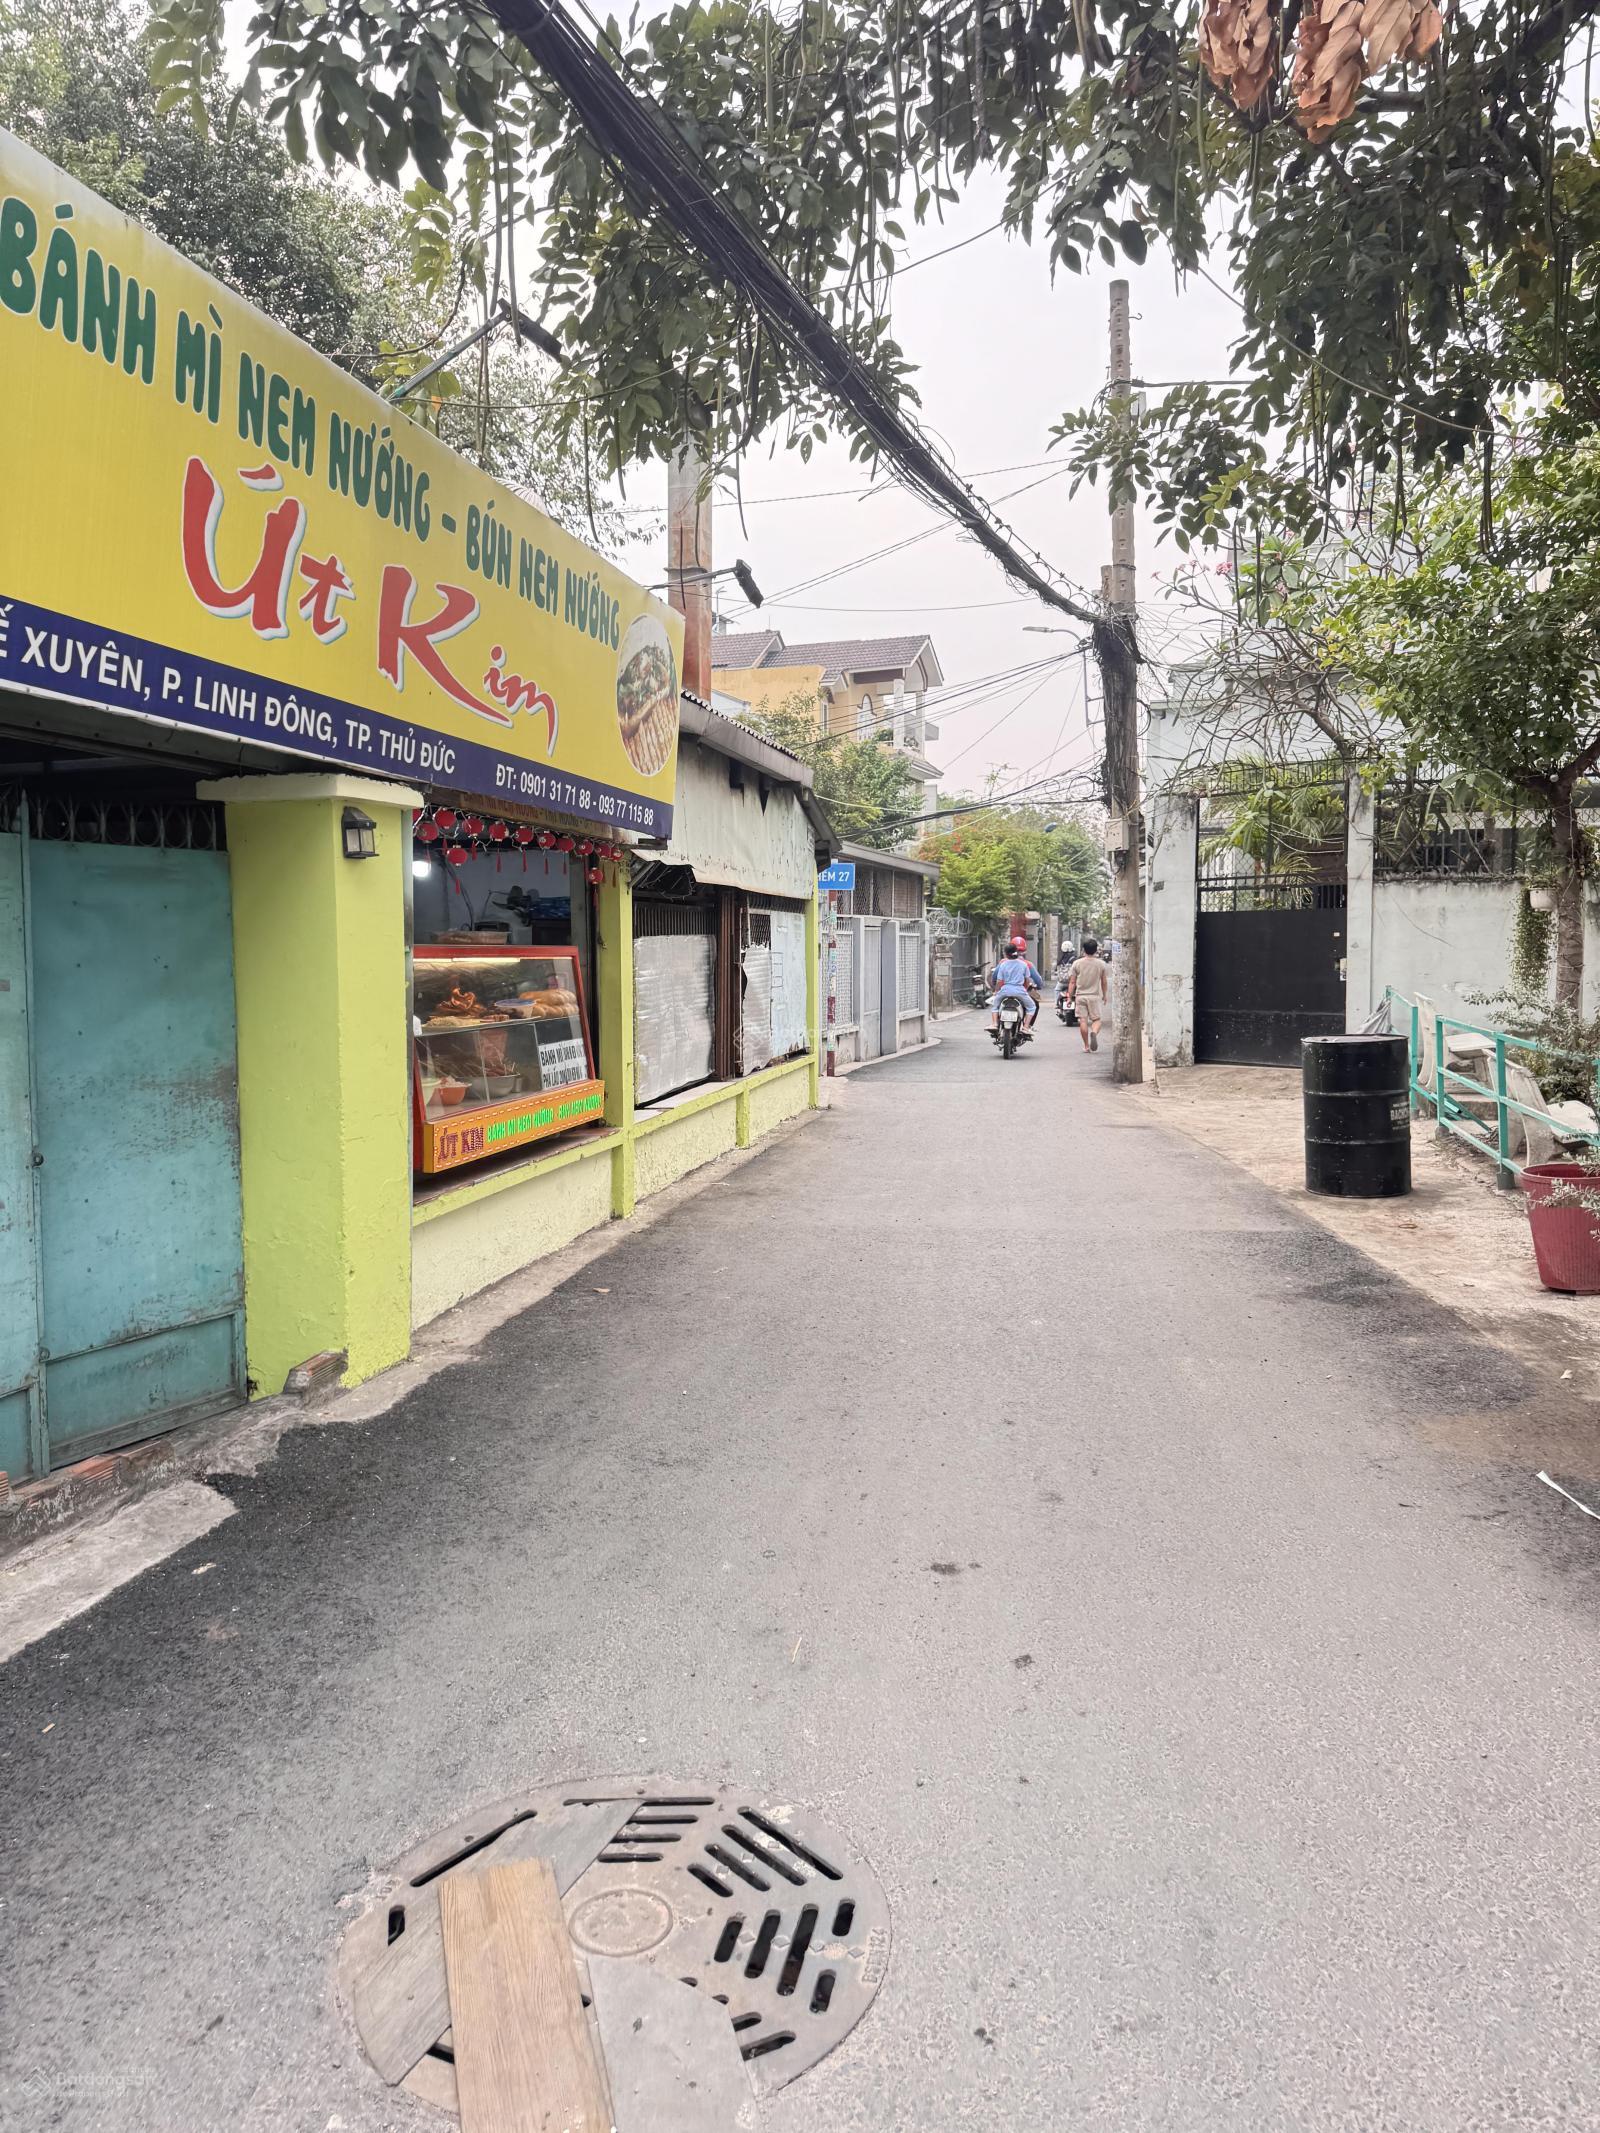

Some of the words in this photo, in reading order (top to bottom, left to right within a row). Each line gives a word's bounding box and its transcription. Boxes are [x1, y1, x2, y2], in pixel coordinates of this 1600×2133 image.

[0, 197, 156, 385] BÁNH
[175, 303, 223, 424] MÌ
[238, 352, 316, 477] NEM
[329, 411, 431, 542] NƯỚNG
[465, 499, 512, 589] BÚN
[519, 537, 559, 616] NEM
[564, 567, 620, 651] NƯỚNG
[21, 626, 151, 702] XUYÊN,
[162, 667, 183, 704] P.
[194, 676, 256, 722] LINH
[264, 694, 337, 749] ĐÔNG,
[346, 719, 372, 753] TP.
[380, 727, 415, 764] THỦ
[420, 741, 455, 774] ĐỨC
[496, 764, 517, 790] ĐT:
[520, 772, 546, 797] 0901
[550, 780, 561, 802] 31
[565, 785, 576, 806] 71
[579, 789, 590, 810] 88
[599, 794, 615, 816] 093
[616, 800, 627, 819] 77
[629, 803, 642, 824] 115
[644, 808, 653, 826] 88
[378, 564, 559, 757] Kim
[838, 871, 850, 882] 27
